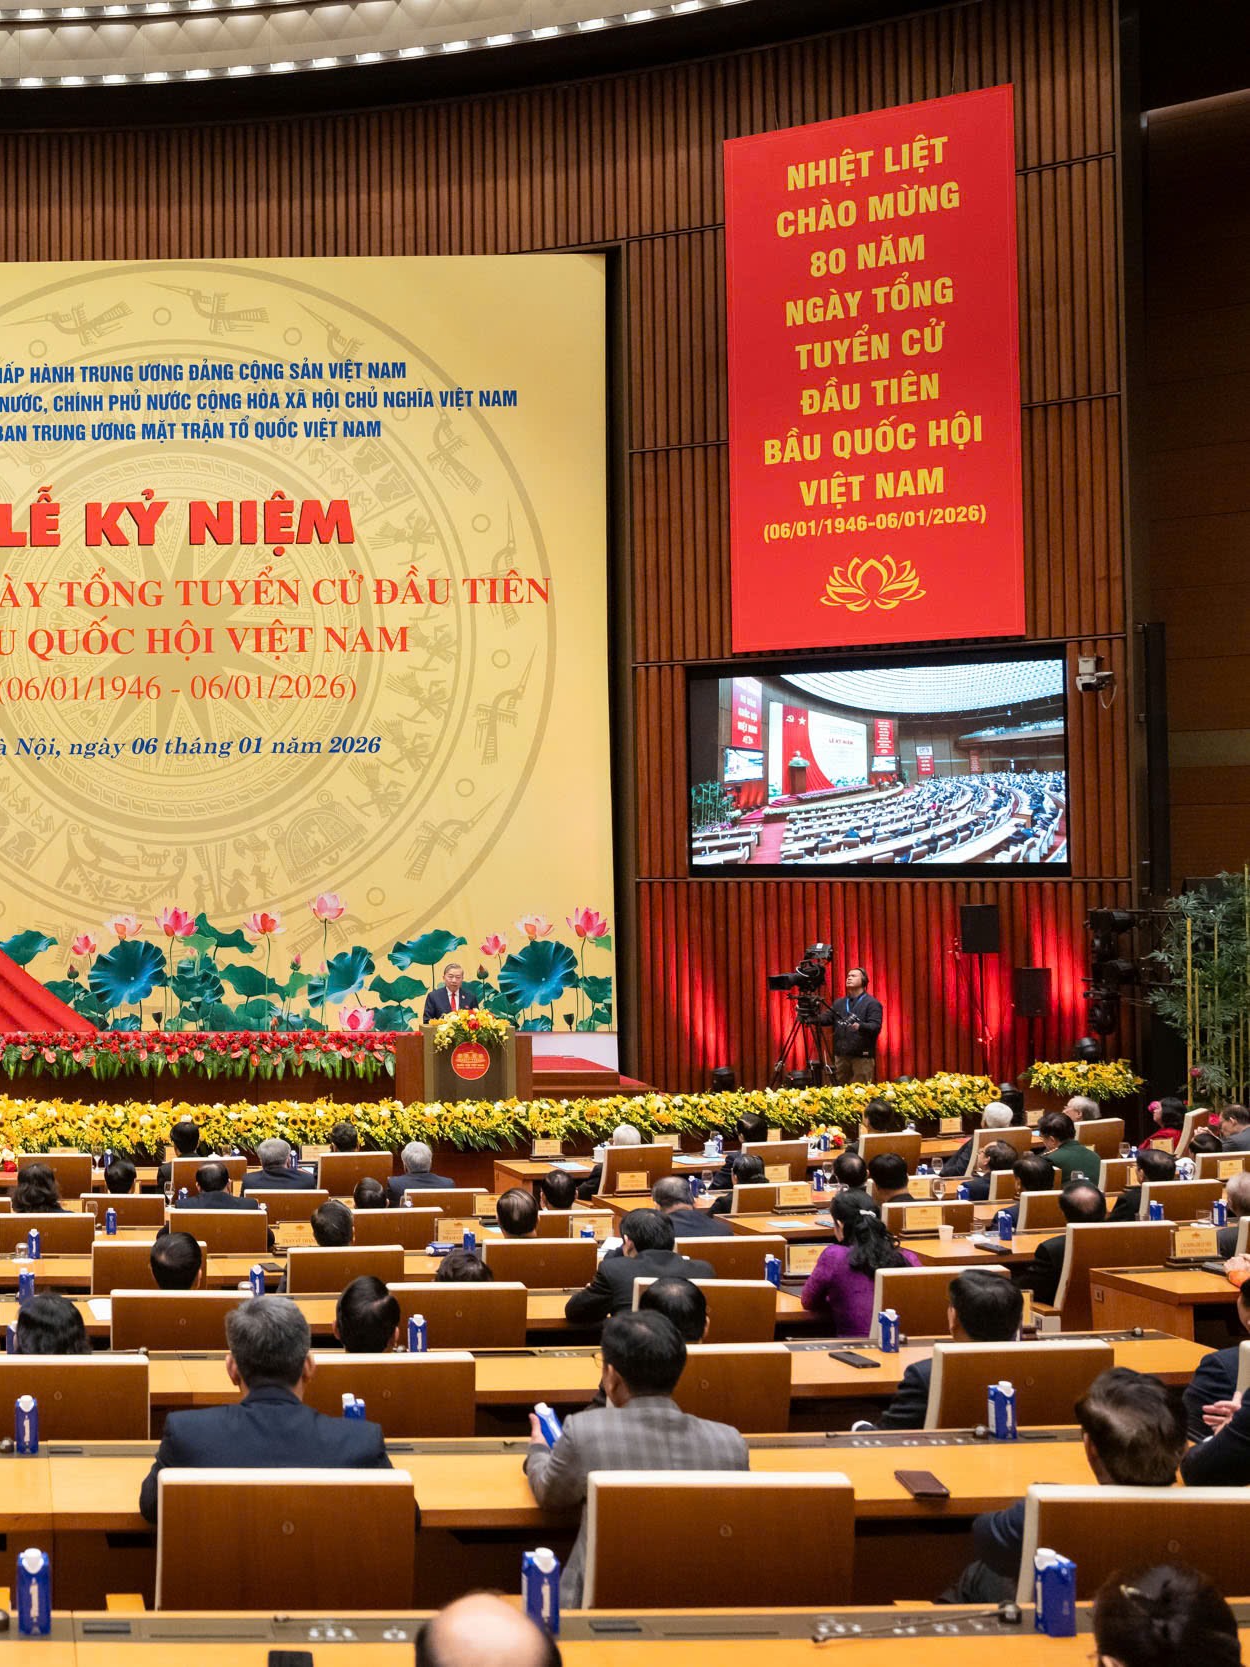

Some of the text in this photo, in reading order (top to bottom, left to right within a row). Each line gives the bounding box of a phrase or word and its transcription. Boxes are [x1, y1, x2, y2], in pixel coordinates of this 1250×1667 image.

[788, 135, 948, 191] NHIỆT LIỆT
[777, 182, 959, 237] CHÀO MỪNG
[811, 234, 924, 277] 80 NĂM
[786, 272, 953, 326] NGÀY TỔNG
[795, 318, 945, 369] TUYỂN CỬ
[30, 364, 74, 383] HÀNH
[80, 365, 133, 382] TRUNG
[139, 364, 183, 381] ƯƠNG
[189, 358, 233, 380] ĐẢNG
[239, 360, 284, 383] CỘNG
[290, 358, 323, 379] SẢN
[329, 360, 362, 382] VIỆT
[368, 362, 406, 378] NAM
[54, 392, 103, 412] CHÍNH
[109, 389, 141, 411] PHỦ
[147, 391, 191, 410] NƯỚC
[197, 390, 241, 413] CỘNG
[247, 389, 279, 409] HÒA
[286, 392, 306, 408] XÃ
[313, 389, 339, 408] HỘI
[345, 386, 377, 408] CHỦ
[384, 391, 434, 407] NGHĨA
[439, 388, 473, 410] VIỆT
[479, 390, 517, 406] NAM
[801, 370, 938, 415] ĐẦU TIÊN
[32, 424, 85, 441] TRUNG
[92, 423, 135, 440] ƯƠNG
[142, 420, 176, 443] MẶT
[181, 419, 224, 442] TRẬN
[230, 416, 249, 438] TỔ
[255, 416, 299, 437] QUỐC
[304, 418, 337, 440] VIỆT
[343, 421, 381, 437] NAM
[765, 411, 981, 464] BẦU QUỐC HỘI
[799, 467, 943, 509] VIỆT NAM
[86, 488, 168, 546] KỶ
[190, 490, 355, 556] NIỆM
[764, 504, 986, 543] (06/01/1946-06/01/2026)
[59, 566, 163, 608] TỔNG
[175, 566, 300, 606] TUYỂN
[312, 569, 364, 606] CỬ
[374, 565, 450, 605] ĐẦU
[462, 569, 550, 604] TIÊN
[28, 615, 134, 662] QUỐC
[146, 619, 214, 662] HỘI
[226, 618, 313, 661] VIỆT
[324, 626, 408, 653] NAM
[190, 674, 356, 701] 06/01/2026)
[16, 738, 60, 760] Nội,
[70, 738, 125, 758] ngày
[132, 738, 158, 754] 06
[166, 737, 234, 756] tháng
[239, 738, 261, 753] 01
[273, 738, 321, 753] năm
[329, 737, 381, 753] 2026
